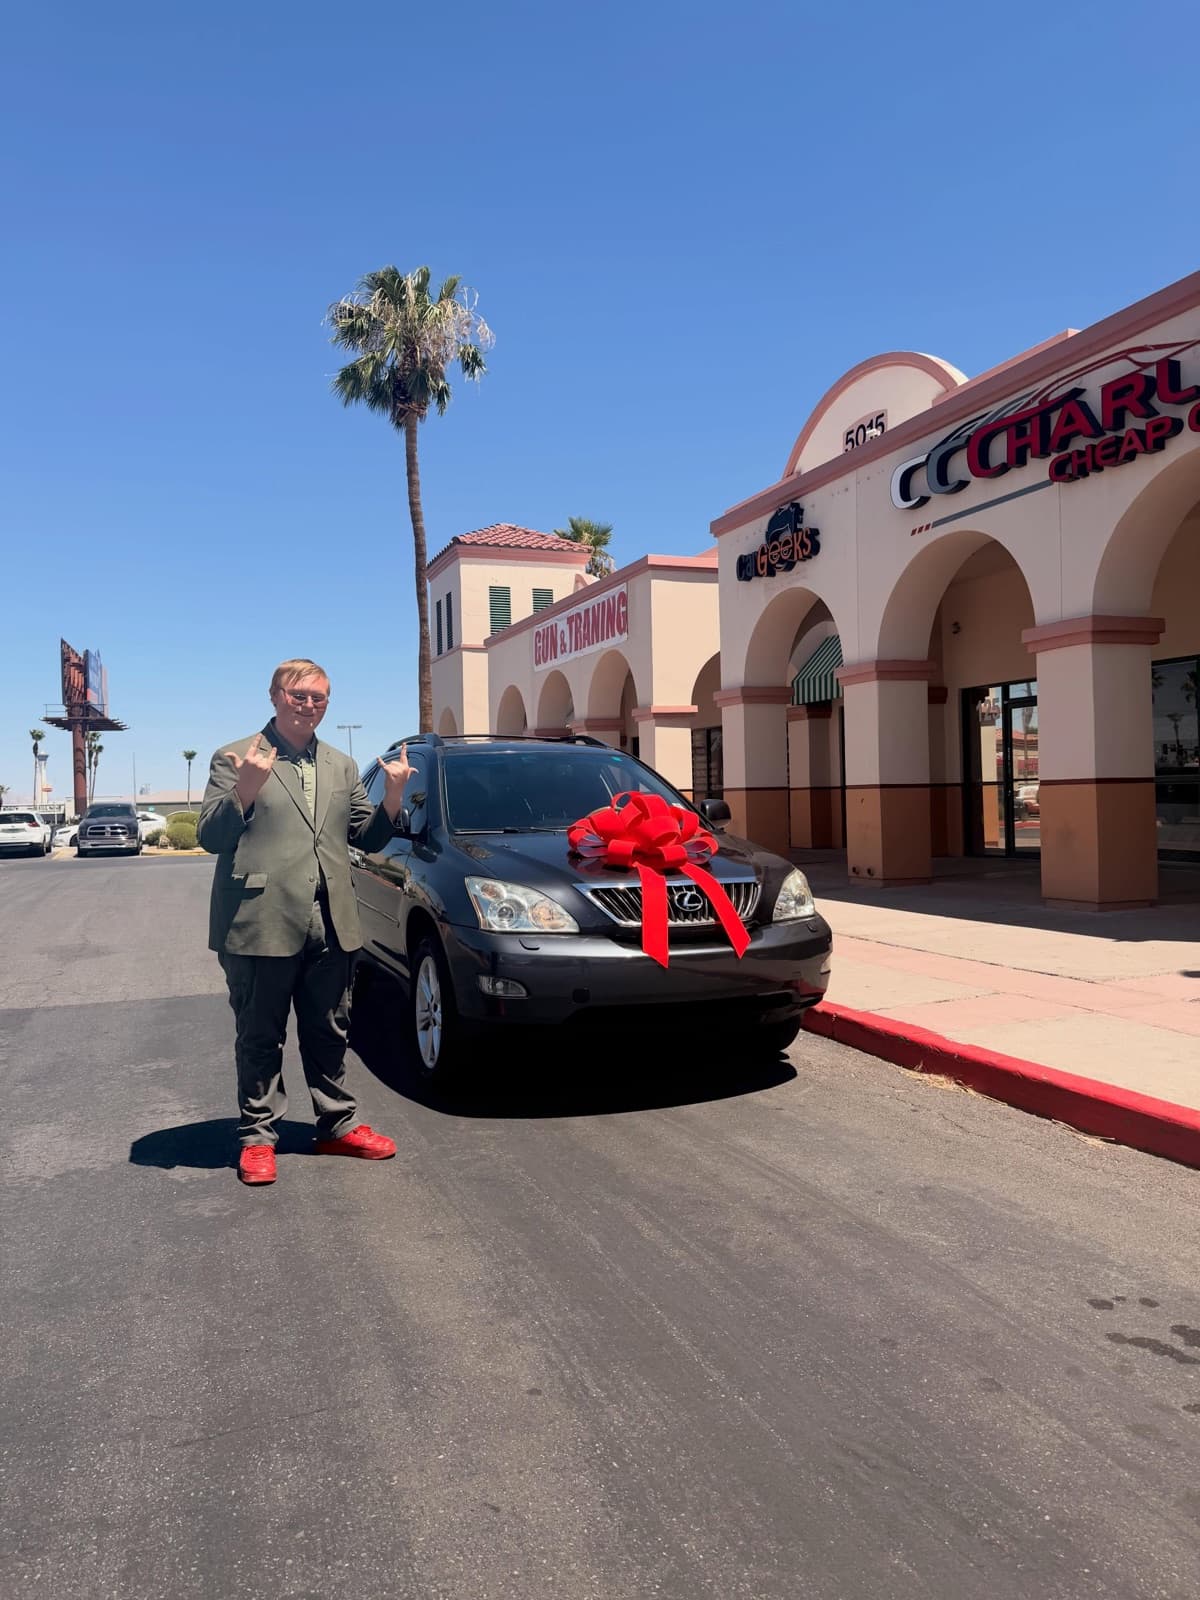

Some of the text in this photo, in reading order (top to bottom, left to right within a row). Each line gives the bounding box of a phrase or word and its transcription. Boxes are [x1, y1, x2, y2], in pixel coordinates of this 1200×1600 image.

[844, 412, 885, 452] 5015
[1049, 416, 1183, 482] CHEAP
[535, 591, 627, 666] GUN & TRANING
[976, 696, 1001, 722] 125
